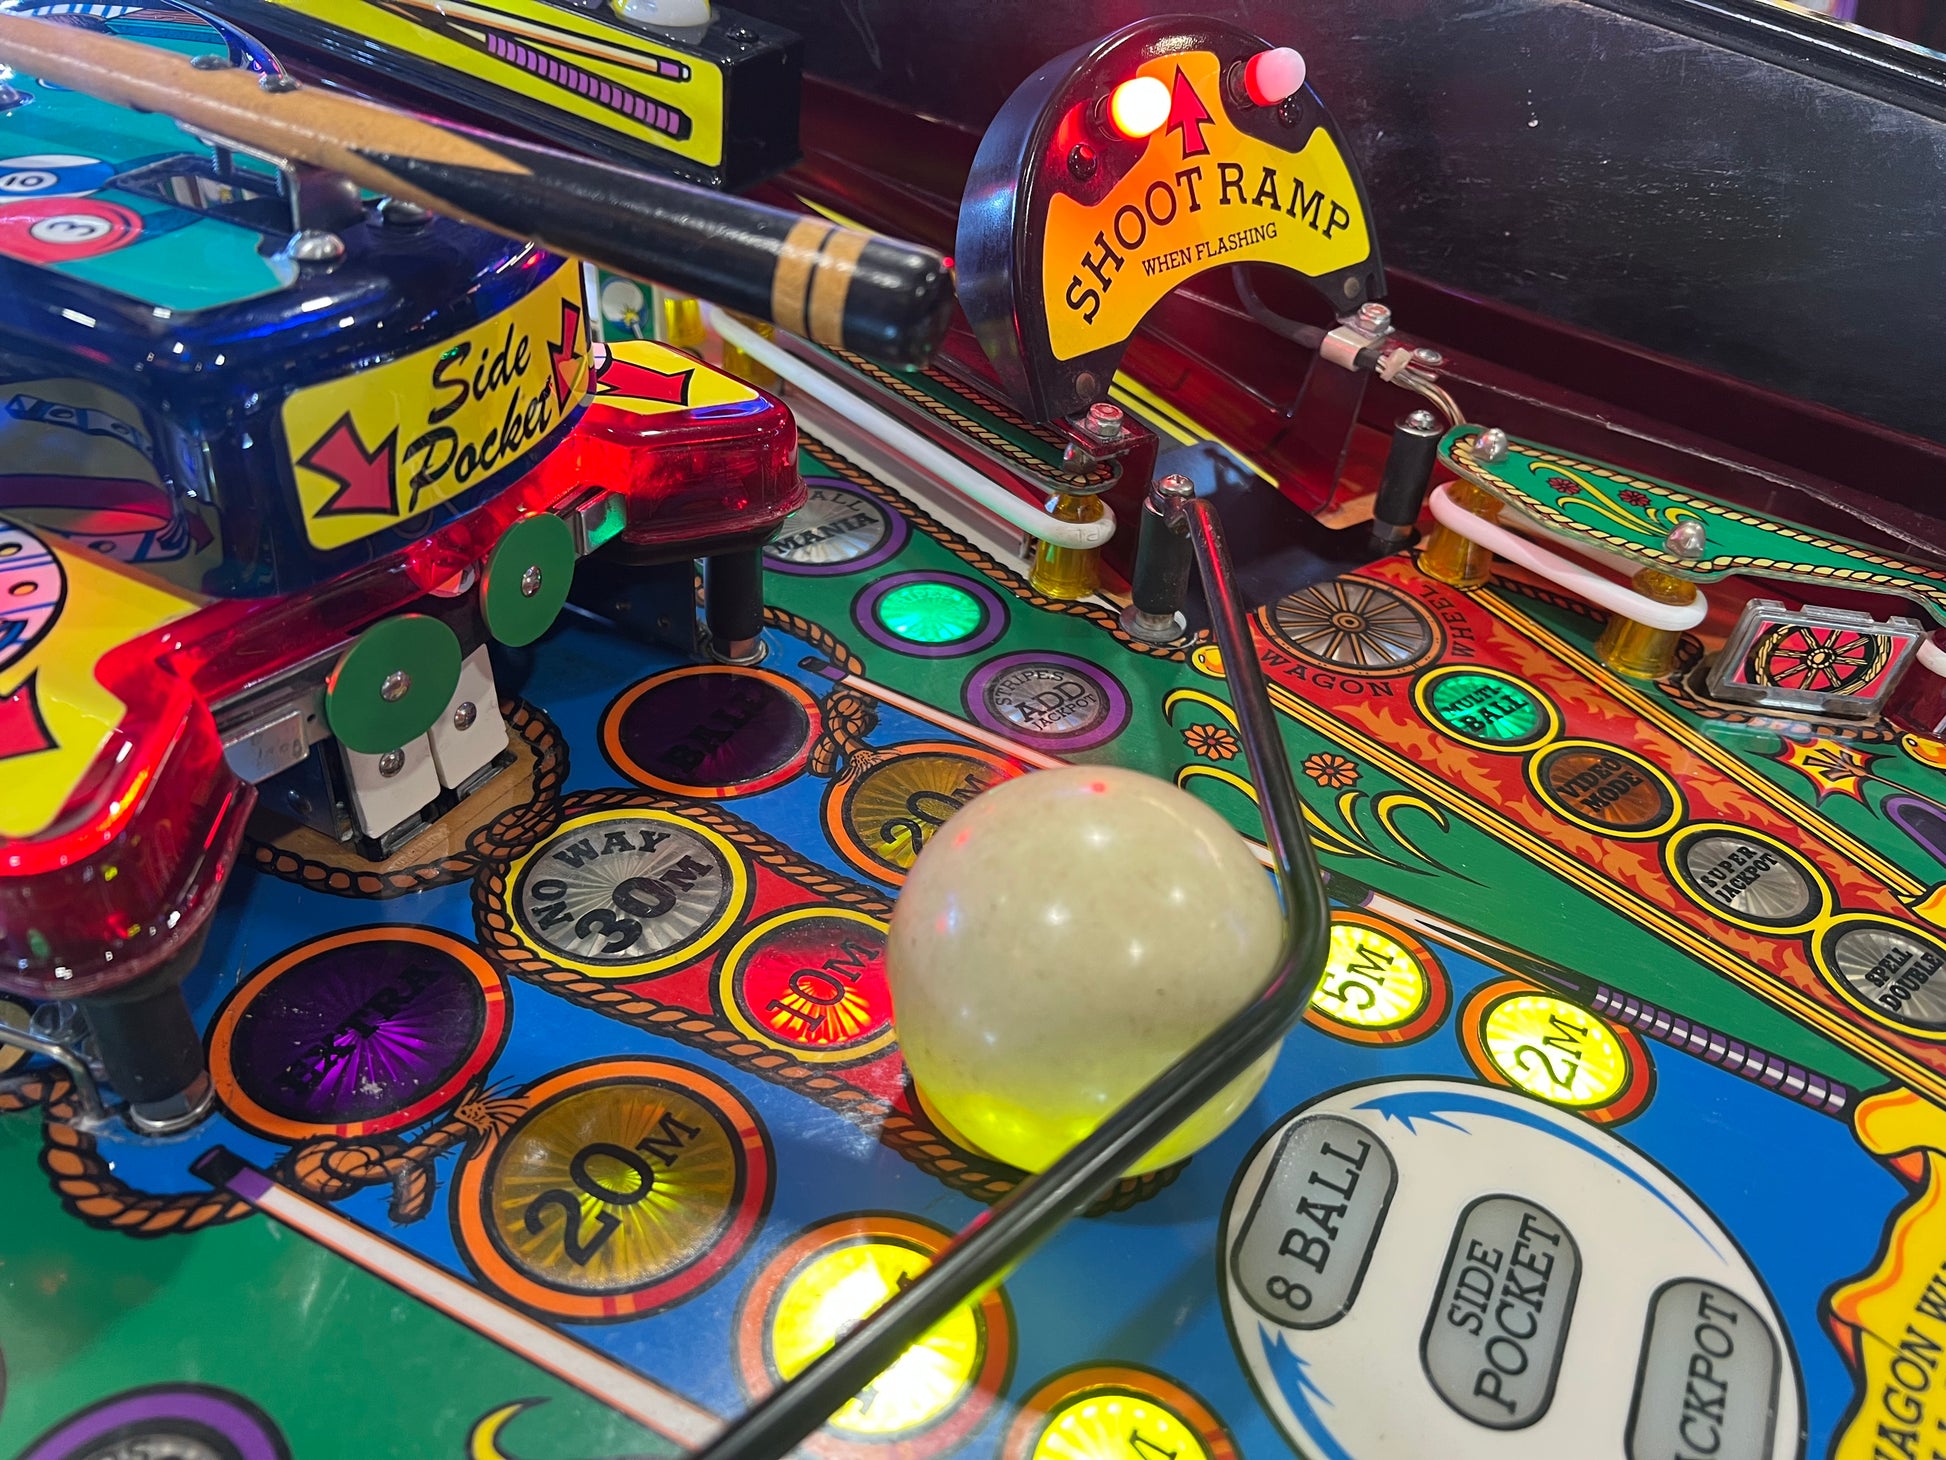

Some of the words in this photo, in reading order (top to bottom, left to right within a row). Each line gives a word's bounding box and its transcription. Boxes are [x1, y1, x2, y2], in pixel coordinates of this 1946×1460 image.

[4, 175, 44, 188] 10
[48, 221, 95, 237] 3
[1065, 165, 1203, 325] SHOOT
[1217, 162, 1350, 241] RAMP
[1141, 246, 1193, 278] WHEN
[1195, 222, 1278, 262] FLASHING
[427, 322, 532, 425] Side
[402, 374, 553, 513] Pocket
[809, 490, 863, 512] ALL
[771, 512, 880, 555] MANIA
[1260, 648, 1395, 698] WAGON
[1419, 584, 1476, 659] WHEEL
[995, 669, 1065, 706] STRIPES
[1014, 681, 1086, 723] ADD
[1031, 693, 1097, 731] JACKPOT
[1459, 694, 1530, 733] BALL
[659, 691, 774, 774] BALL
[1555, 756, 1623, 799] VIDEO
[1579, 770, 1644, 813] MODE
[552, 829, 671, 870] WAY
[1700, 846, 1758, 889] SUPER
[530, 878, 575, 931] NO
[574, 853, 714, 955] 30M
[1714, 852, 1778, 904] JACKPOT
[764, 936, 881, 1034] 10M
[1320, 942, 1395, 1012] 5M
[1864, 946, 1914, 988] SPELL
[1878, 951, 1945, 1012] DOUBLE
[271, 963, 443, 1095] EXTRA
[1512, 1013, 1590, 1092] 2M
[523, 1110, 702, 1267] 20M
[1277, 1138, 1372, 1275] BALL
[1265, 1274, 1314, 1312] 8
[1446, 1238, 1504, 1336] SIDE
[1473, 1211, 1562, 1415] POCKET
[1674, 1290, 1739, 1460] CKPOT
